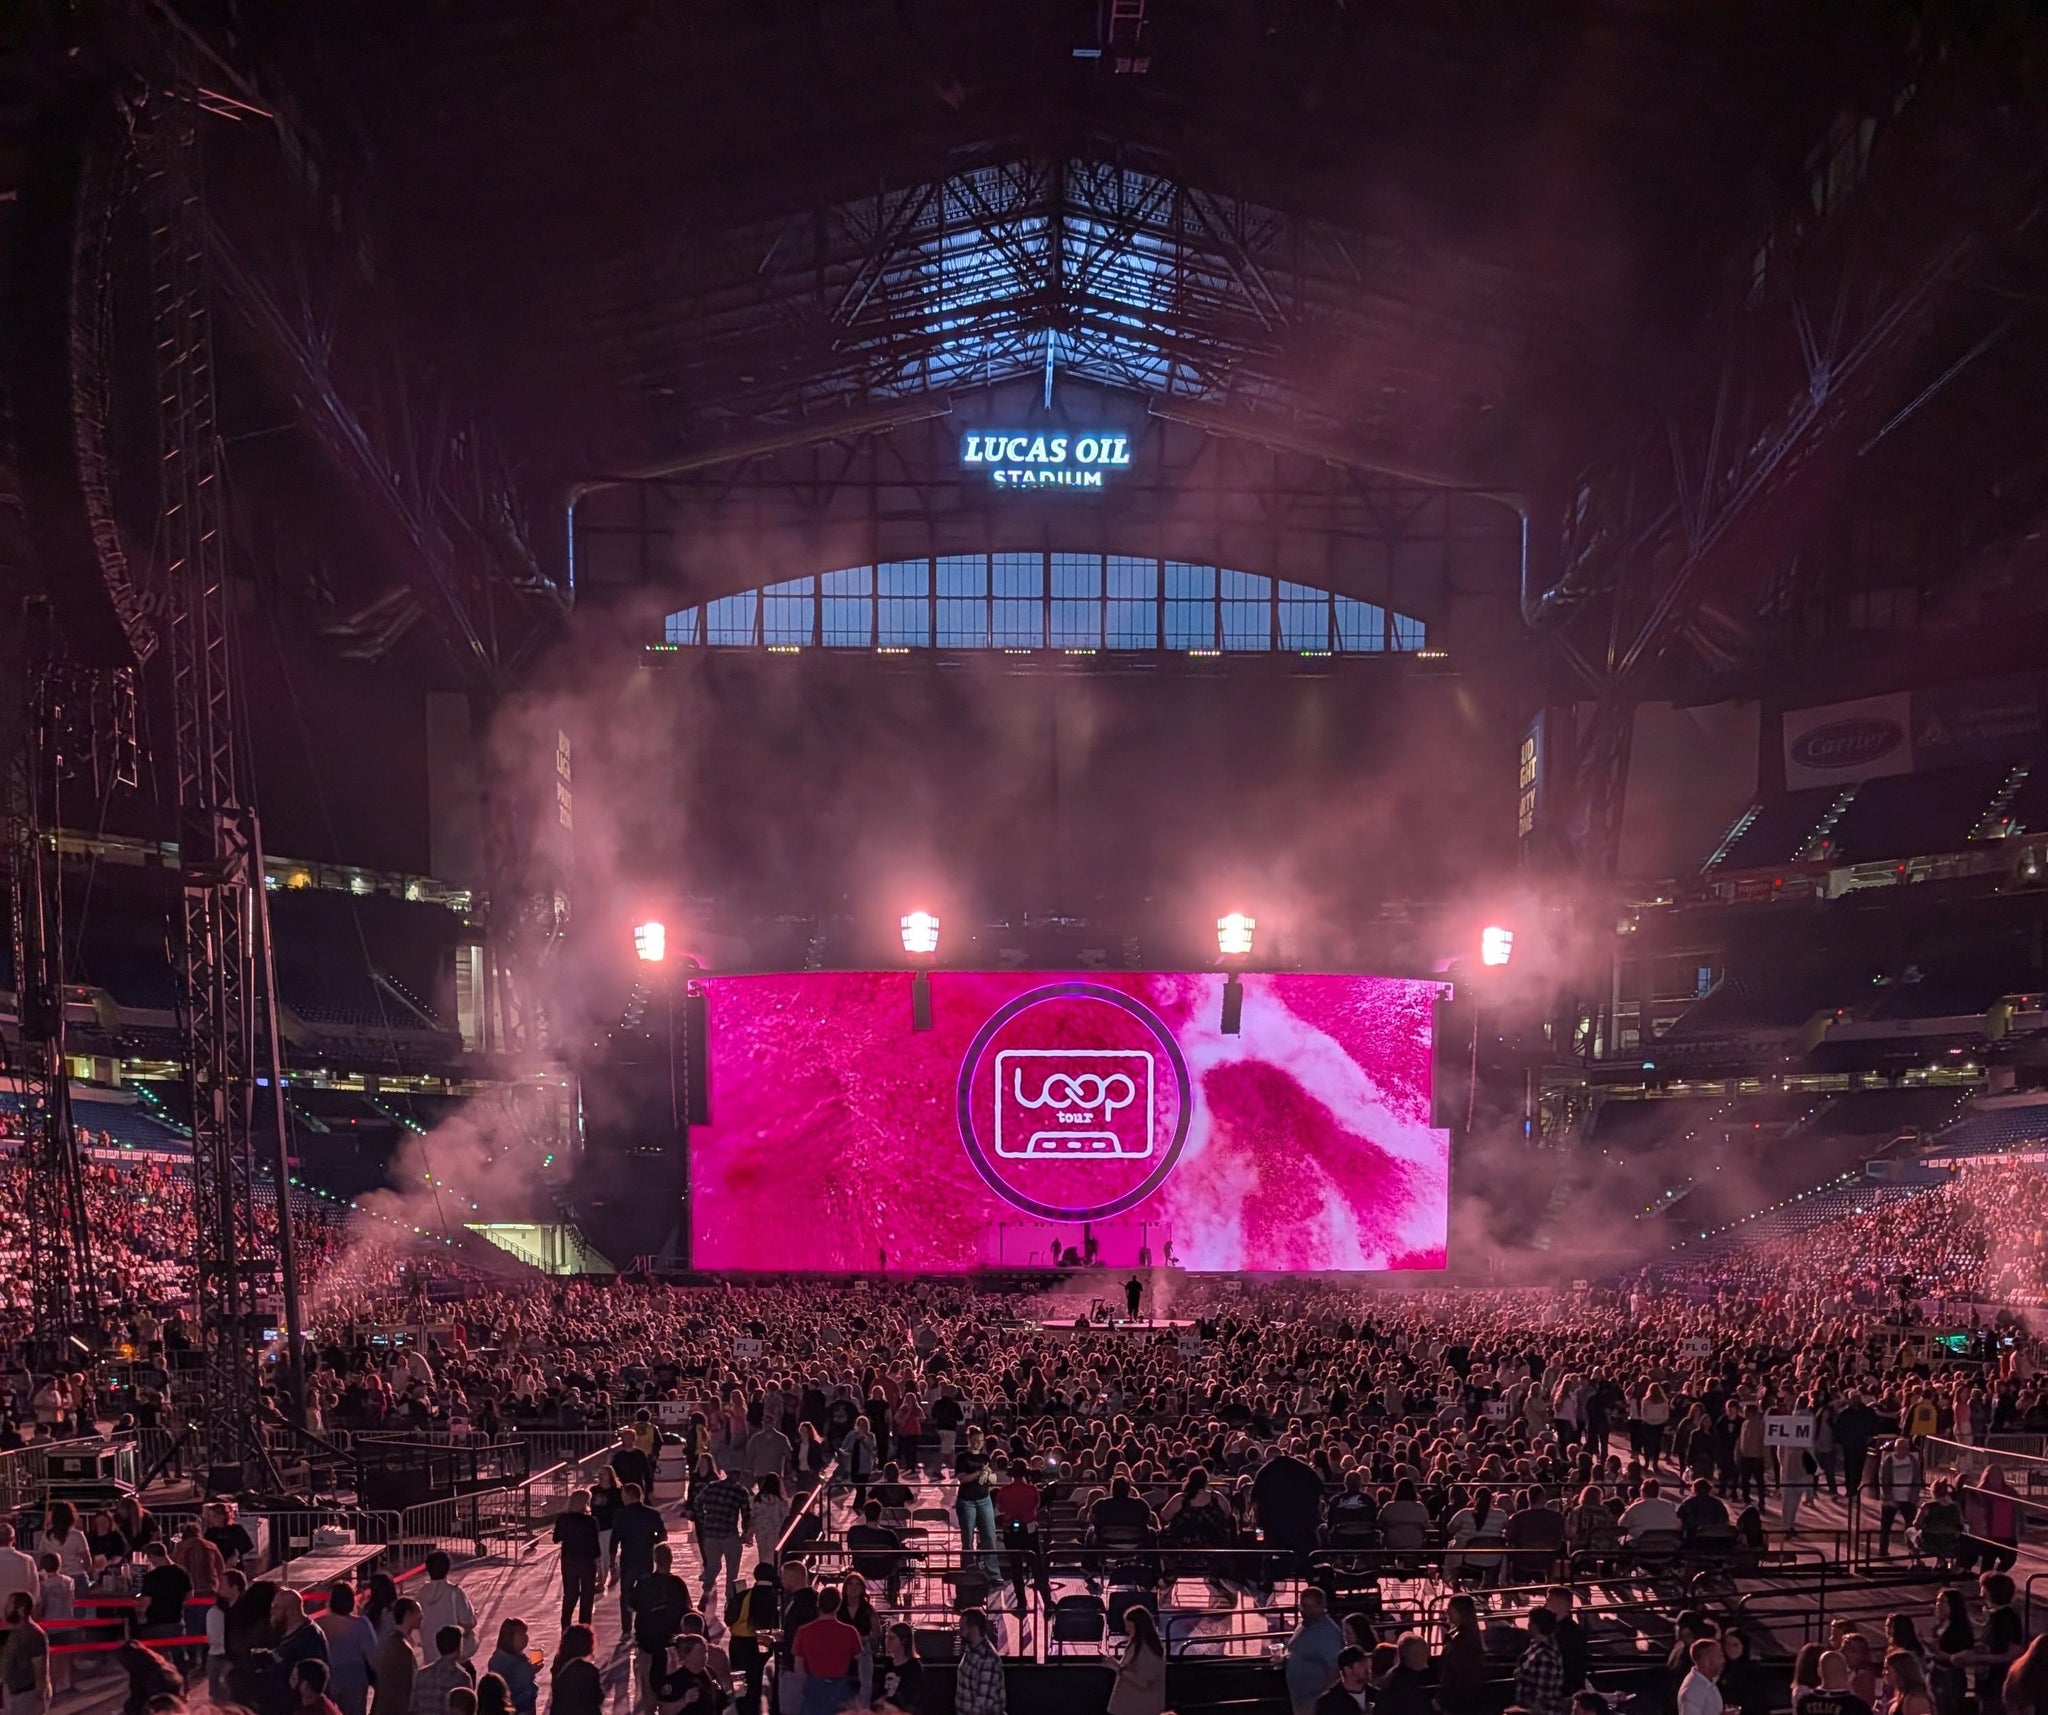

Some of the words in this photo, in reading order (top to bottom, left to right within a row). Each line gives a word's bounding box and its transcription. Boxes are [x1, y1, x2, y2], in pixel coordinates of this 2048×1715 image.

[964, 436, 1068, 463] LUCAS
[1075, 438, 1130, 464] OIL
[993, 469, 1103, 488] STADIUM
[1807, 729, 1889, 757] Carrier
[1056, 1110, 1094, 1124] tour
[736, 1342, 749, 1352] FL
[1180, 1341, 1192, 1350] FL
[1685, 1343, 1698, 1352] FL
[662, 1405, 676, 1414] FL
[678, 1405, 685, 1414] J
[962, 1405, 971, 1414] H
[1496, 1406, 1504, 1415] H
[1768, 1424, 1790, 1437] FL
[1795, 1424, 1810, 1438] M
